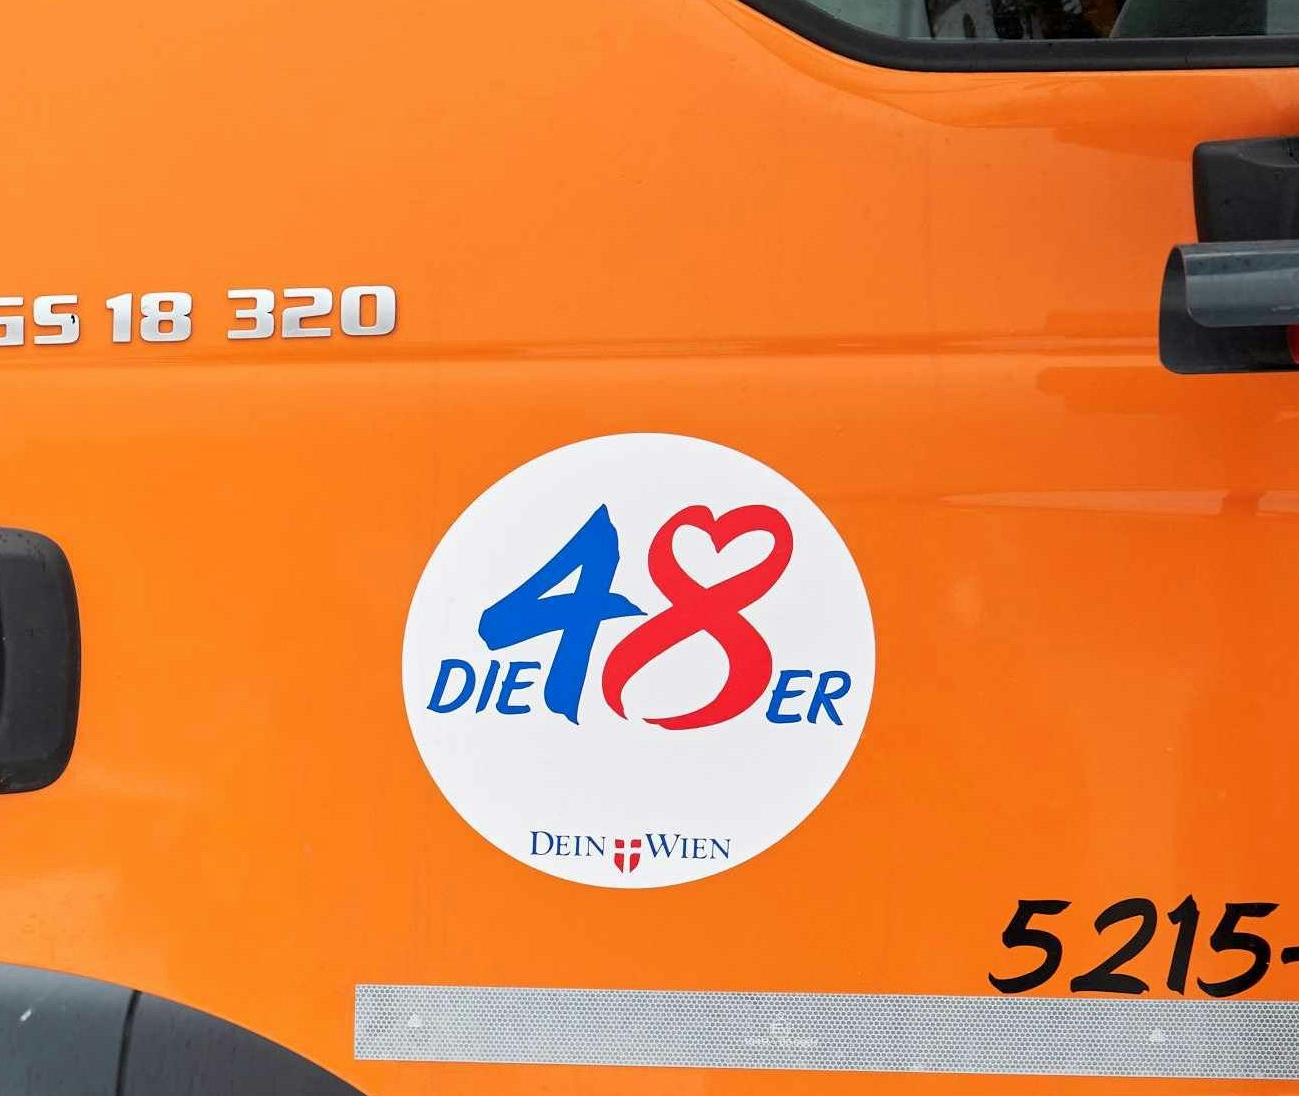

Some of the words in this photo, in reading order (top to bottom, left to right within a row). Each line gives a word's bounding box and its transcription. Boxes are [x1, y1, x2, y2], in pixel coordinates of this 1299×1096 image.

[105, 292, 193, 343] 18
[227, 285, 396, 338] 320
[426, 658, 543, 716] DIE
[530, 830, 607, 858] DEIN
[644, 833, 731, 861] WIEN
